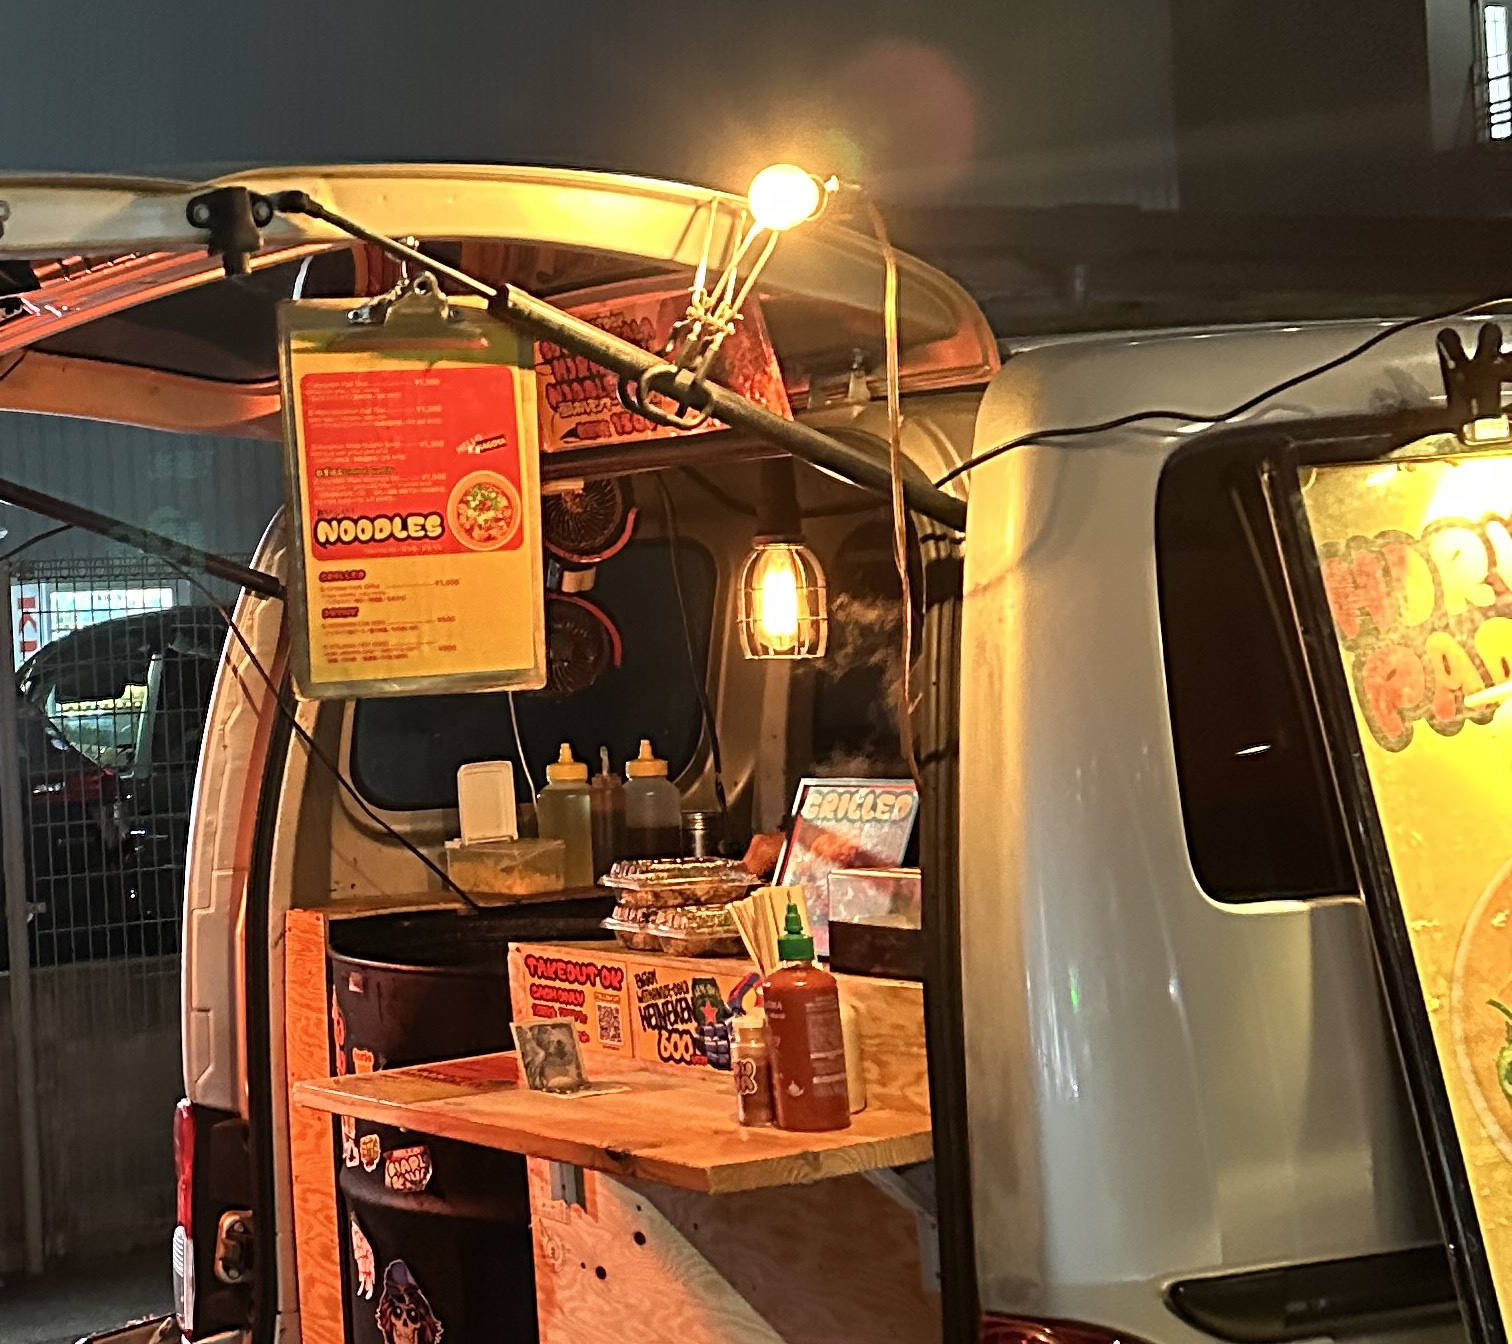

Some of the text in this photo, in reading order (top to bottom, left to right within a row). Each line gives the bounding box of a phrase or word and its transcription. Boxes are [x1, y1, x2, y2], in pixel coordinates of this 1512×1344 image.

[316, 514, 443, 545] NOODLES
[800, 789, 914, 822] GRILLED
[599, 964, 624, 991] OK
